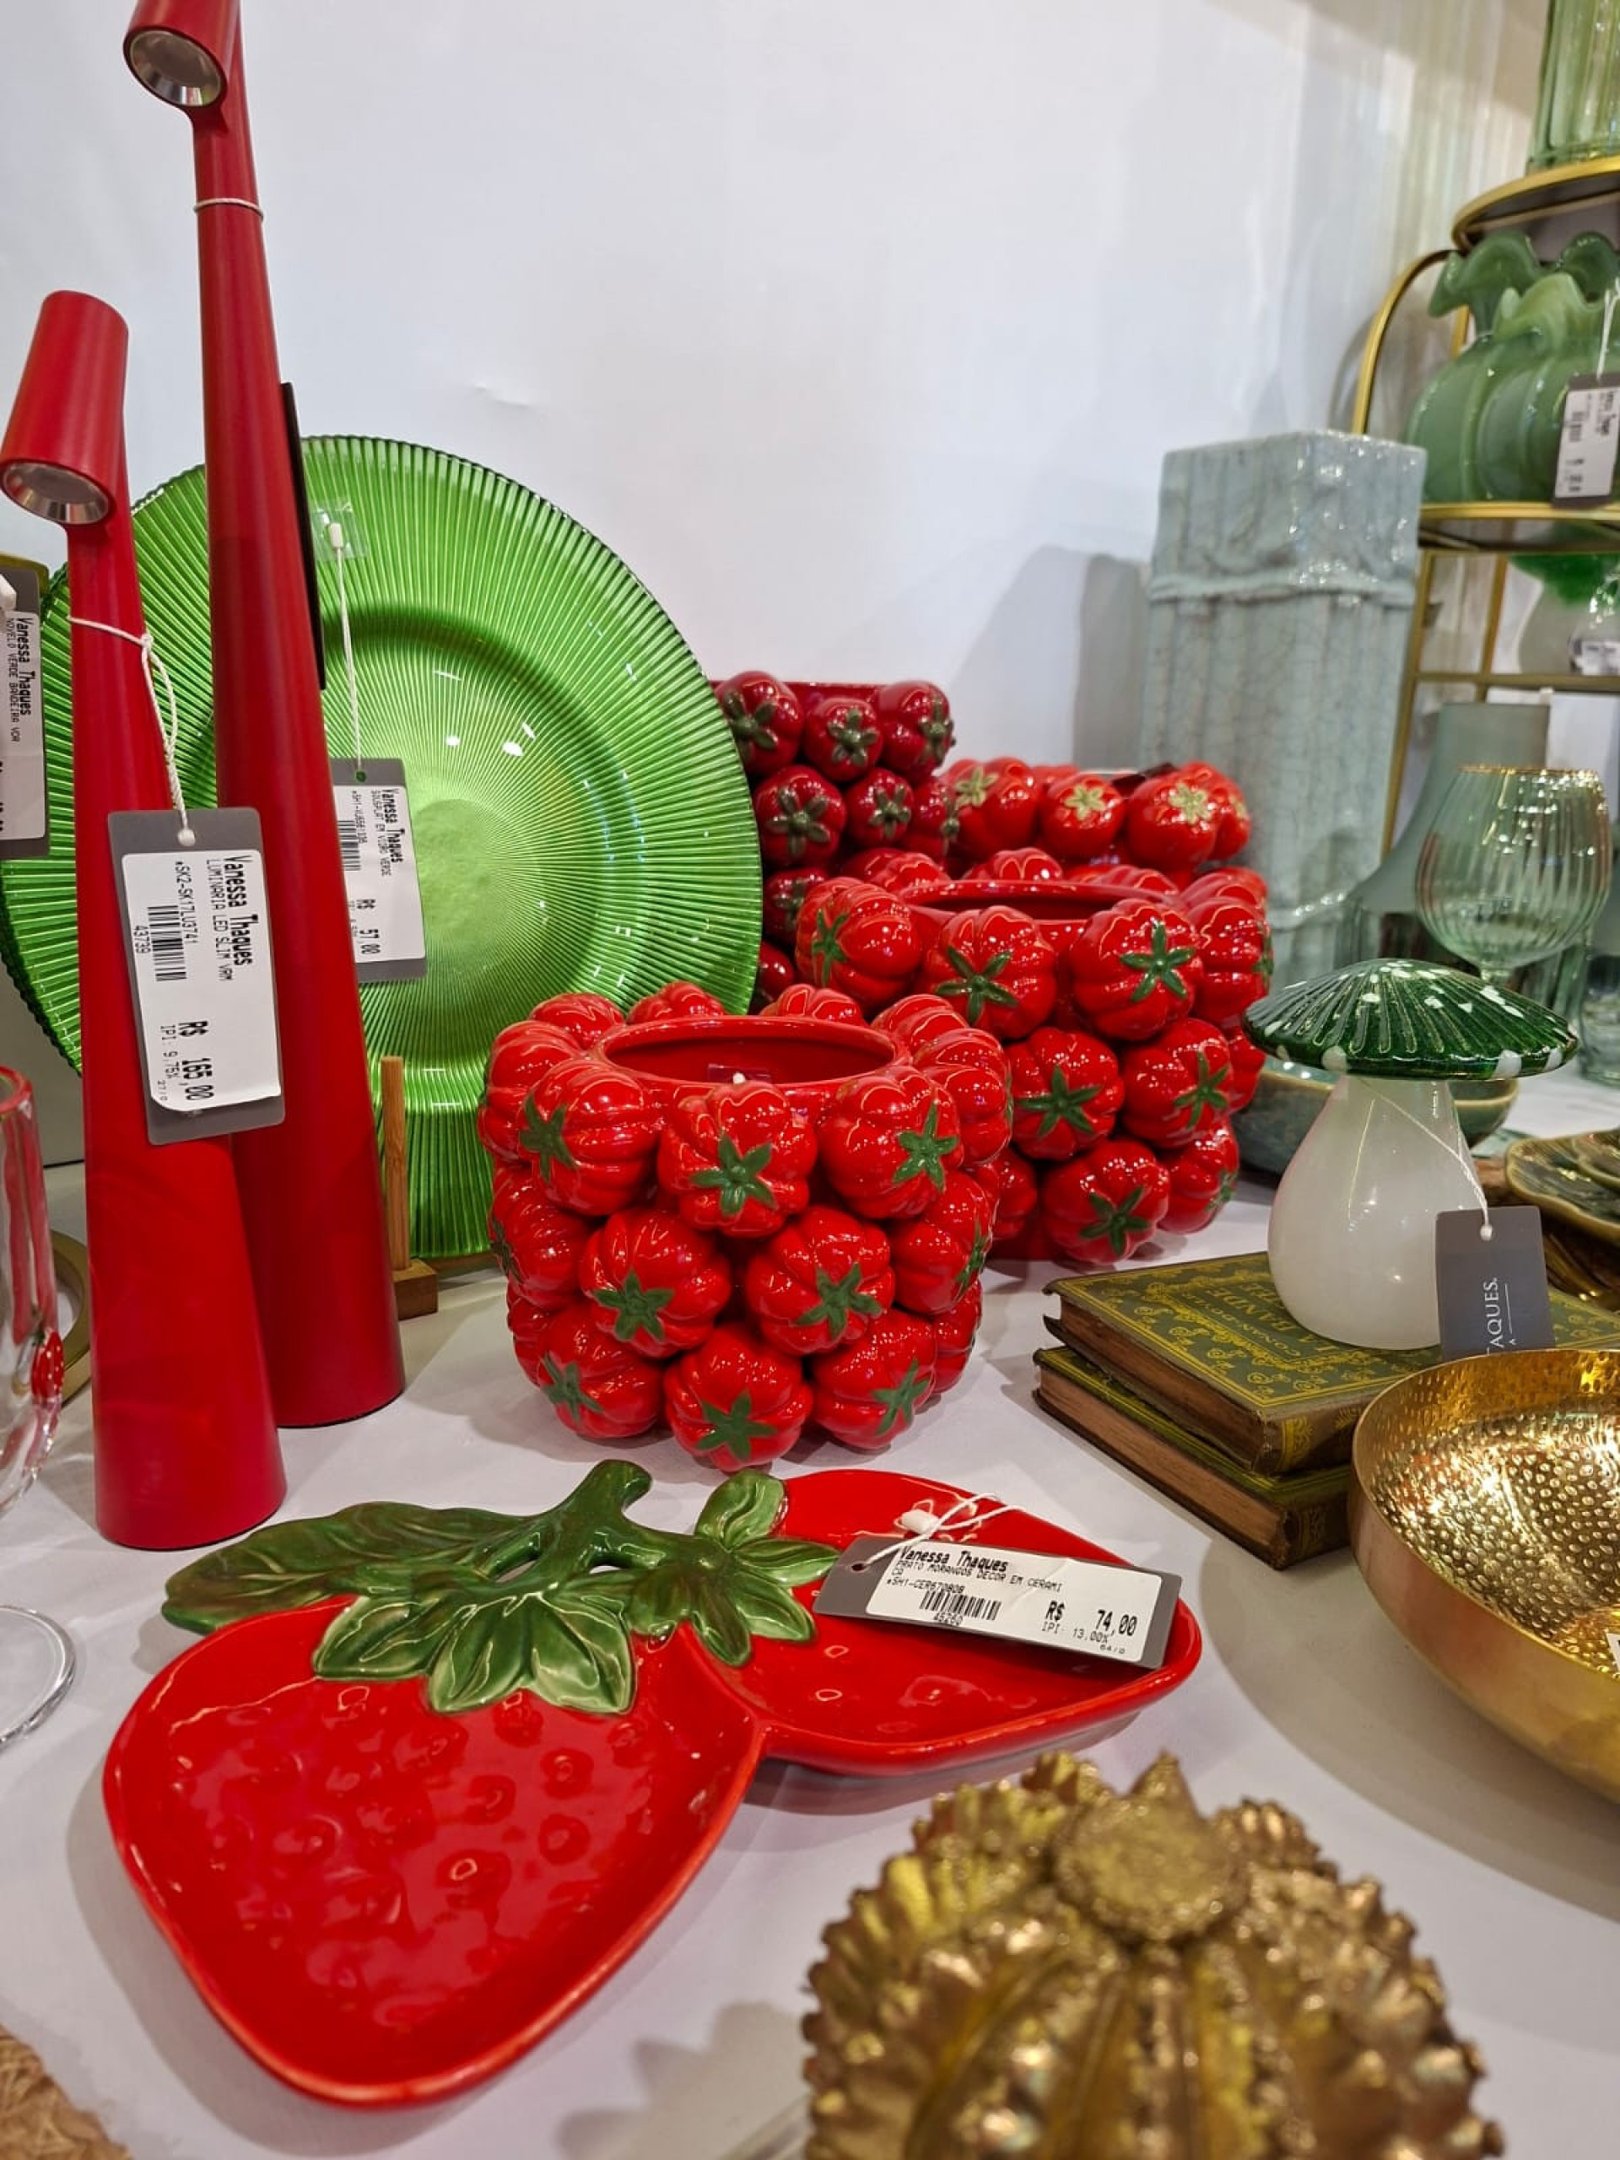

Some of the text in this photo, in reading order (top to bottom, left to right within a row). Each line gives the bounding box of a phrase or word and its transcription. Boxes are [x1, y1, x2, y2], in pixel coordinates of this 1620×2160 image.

[8, 653, 18, 678] VERDE
[16, 617, 36, 716] Vanessa Thaques
[382, 788, 406, 863] Vanessa Thaques
[206, 859, 233, 980] LUMINARIA LED SLIM VRM
[224, 855, 258, 966] Vanessa Thaques
[356, 898, 376, 909] R$
[133, 925, 151, 954] 43739
[178, 1021, 215, 1101] R$ 165,00
[896, 1560, 1062, 1592] PRATO MORANGOS DECOR EM CERAMI
[900, 1546, 1009, 1572] Vanessa Thaques
[1045, 1600, 1138, 1636] R$ 74,00
